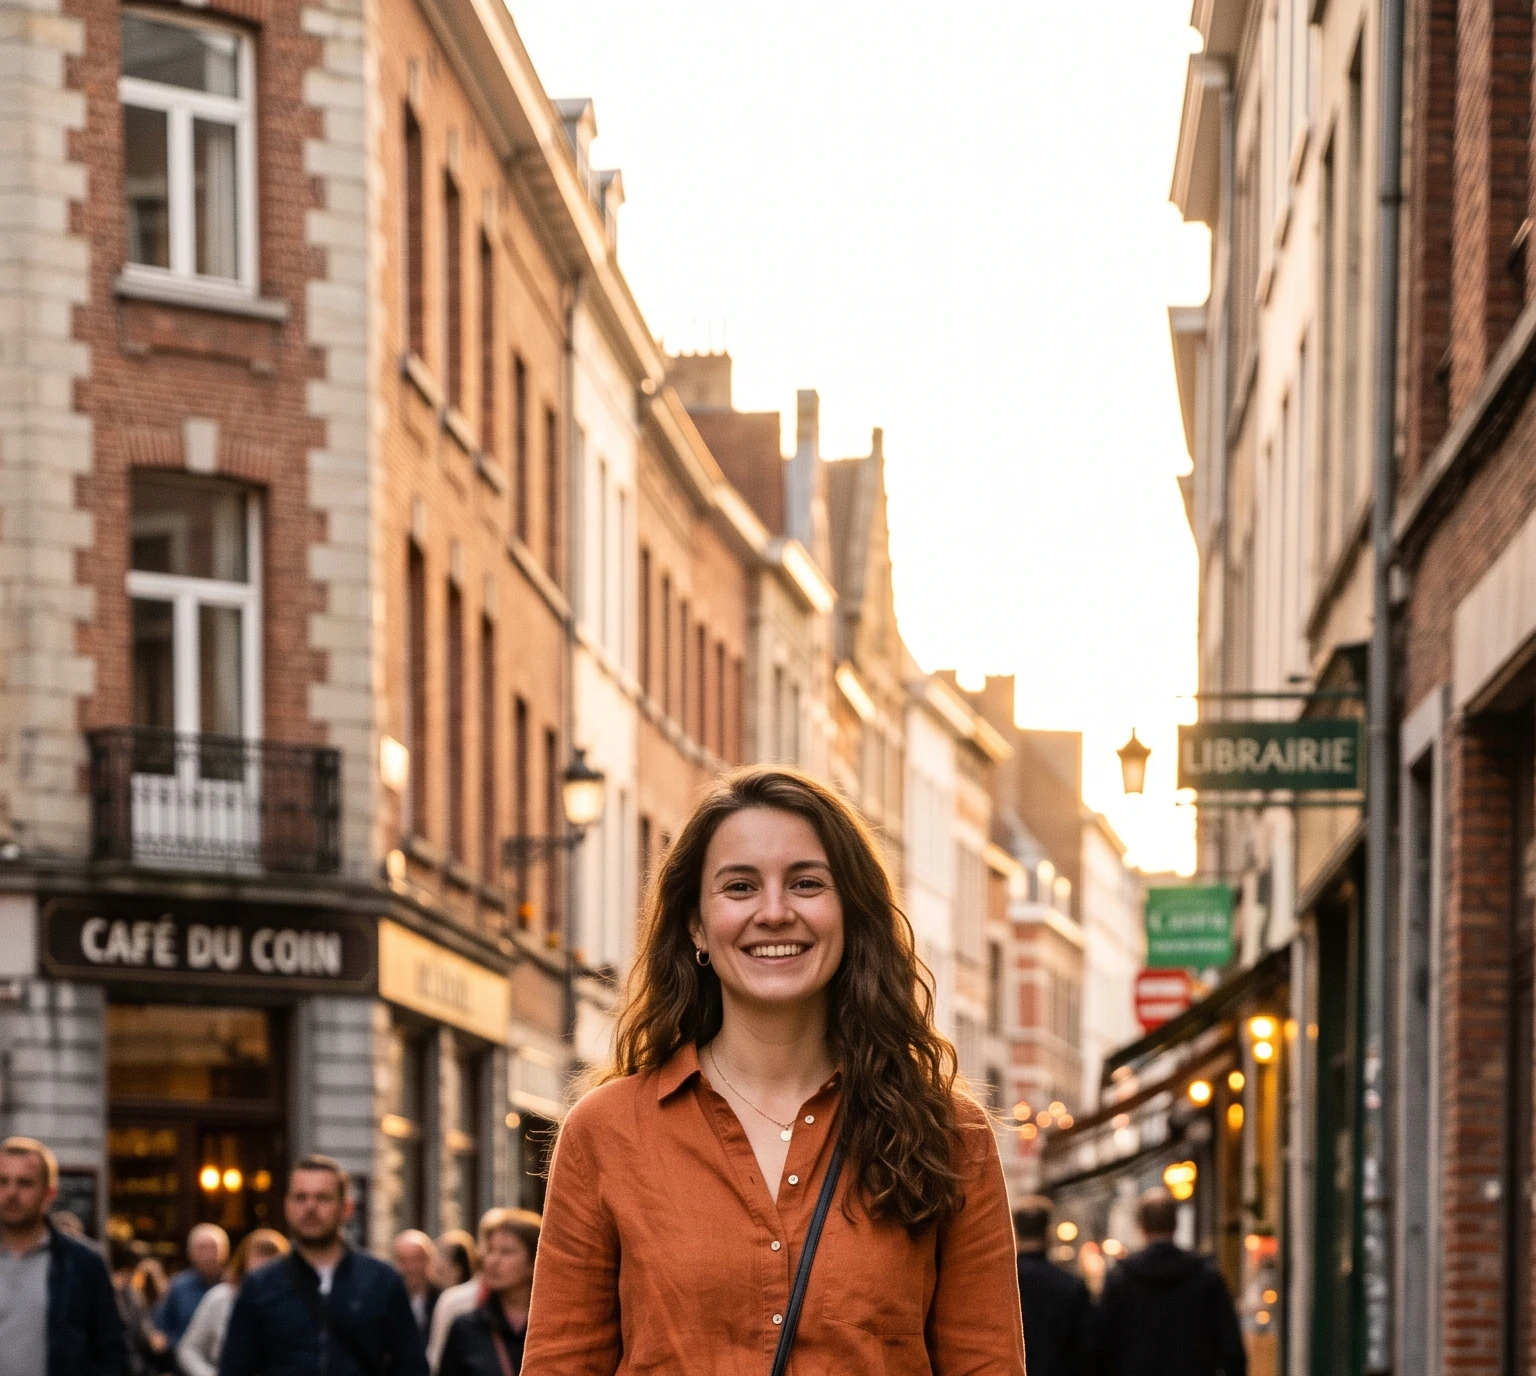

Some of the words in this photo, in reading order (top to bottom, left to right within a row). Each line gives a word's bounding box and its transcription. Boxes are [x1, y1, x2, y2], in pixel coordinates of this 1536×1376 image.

[1183, 737, 1351, 774] LIBRAIRIE
[81, 914, 177, 967] CAFÉ
[187, 924, 242, 971] DU
[251, 928, 342, 976] COIN
